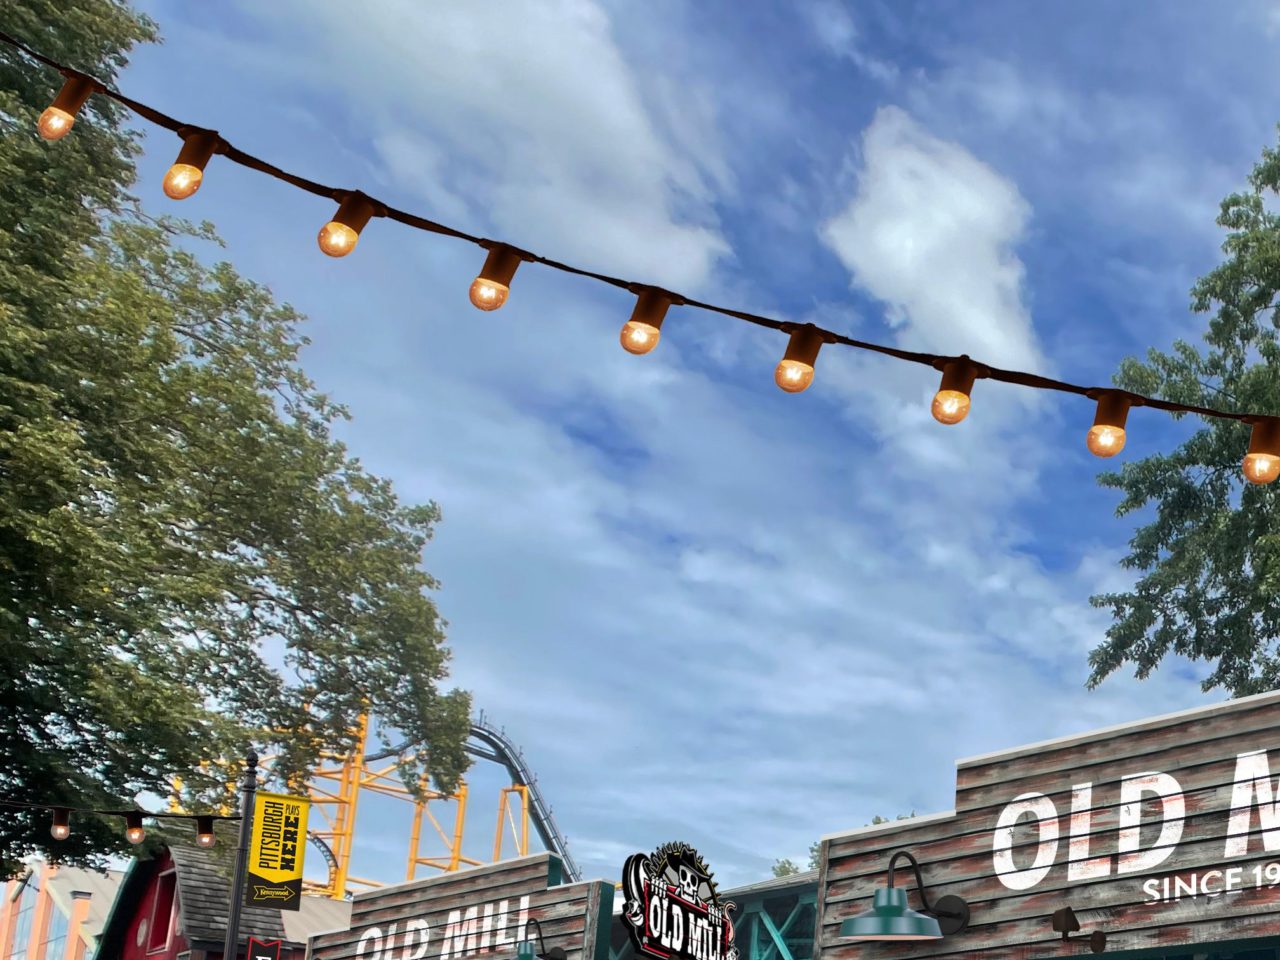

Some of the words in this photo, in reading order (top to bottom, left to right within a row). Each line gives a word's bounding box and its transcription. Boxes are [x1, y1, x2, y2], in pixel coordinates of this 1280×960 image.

[258, 800, 285, 871] PITTSBURGH
[285, 803, 301, 817] PLAYS
[992, 769, 1186, 891] OLD
[280, 815, 300, 872] HERE
[259, 887, 290, 898] Kennywood
[1143, 862, 1243, 906] SINCE
[649, 894, 684, 952] OLD
